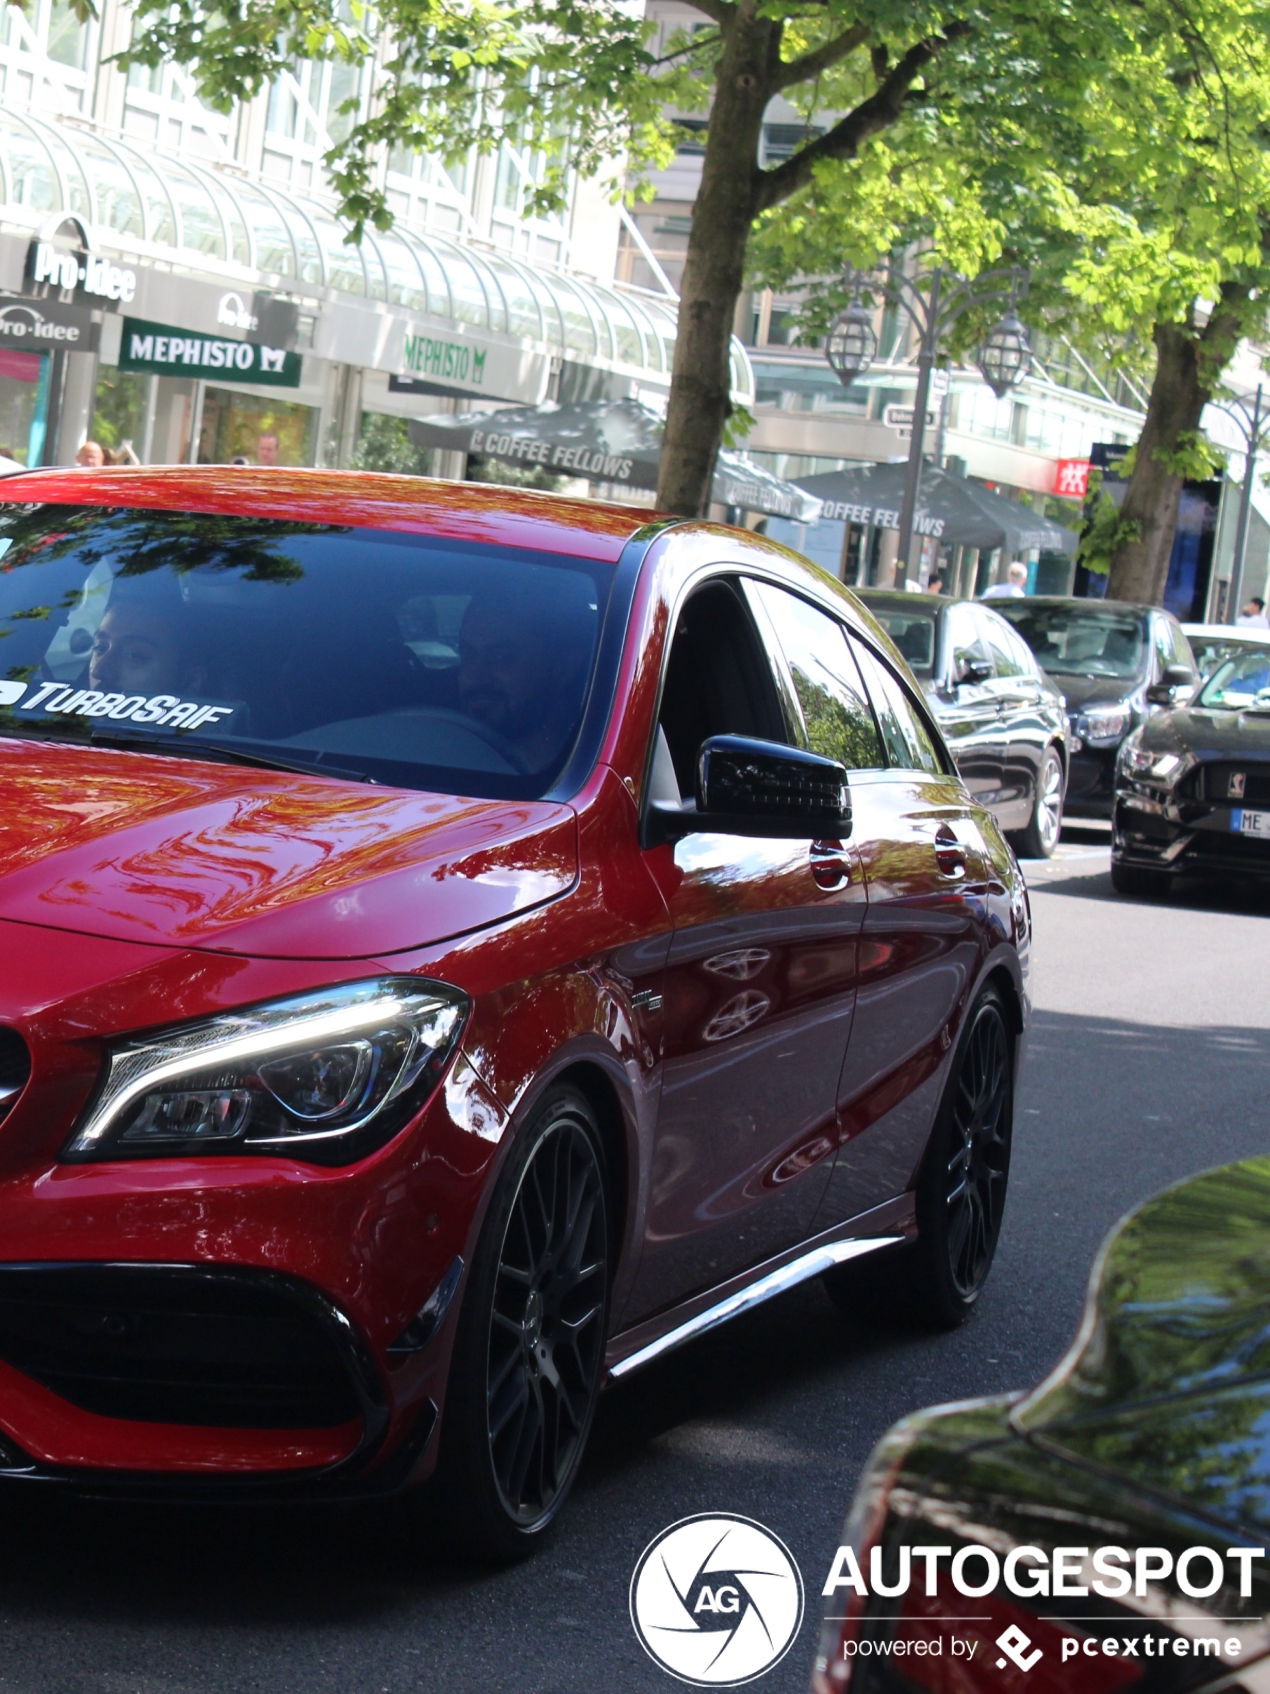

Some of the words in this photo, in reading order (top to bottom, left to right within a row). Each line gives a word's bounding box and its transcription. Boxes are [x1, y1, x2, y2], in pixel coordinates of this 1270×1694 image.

[130, 333, 255, 370] MEPHISTO
[403, 333, 470, 381] MEPHISTO
[484, 433, 551, 463] COFFEE
[551, 444, 633, 480] FELLOWS
[1241, 813, 1262, 831] ME
